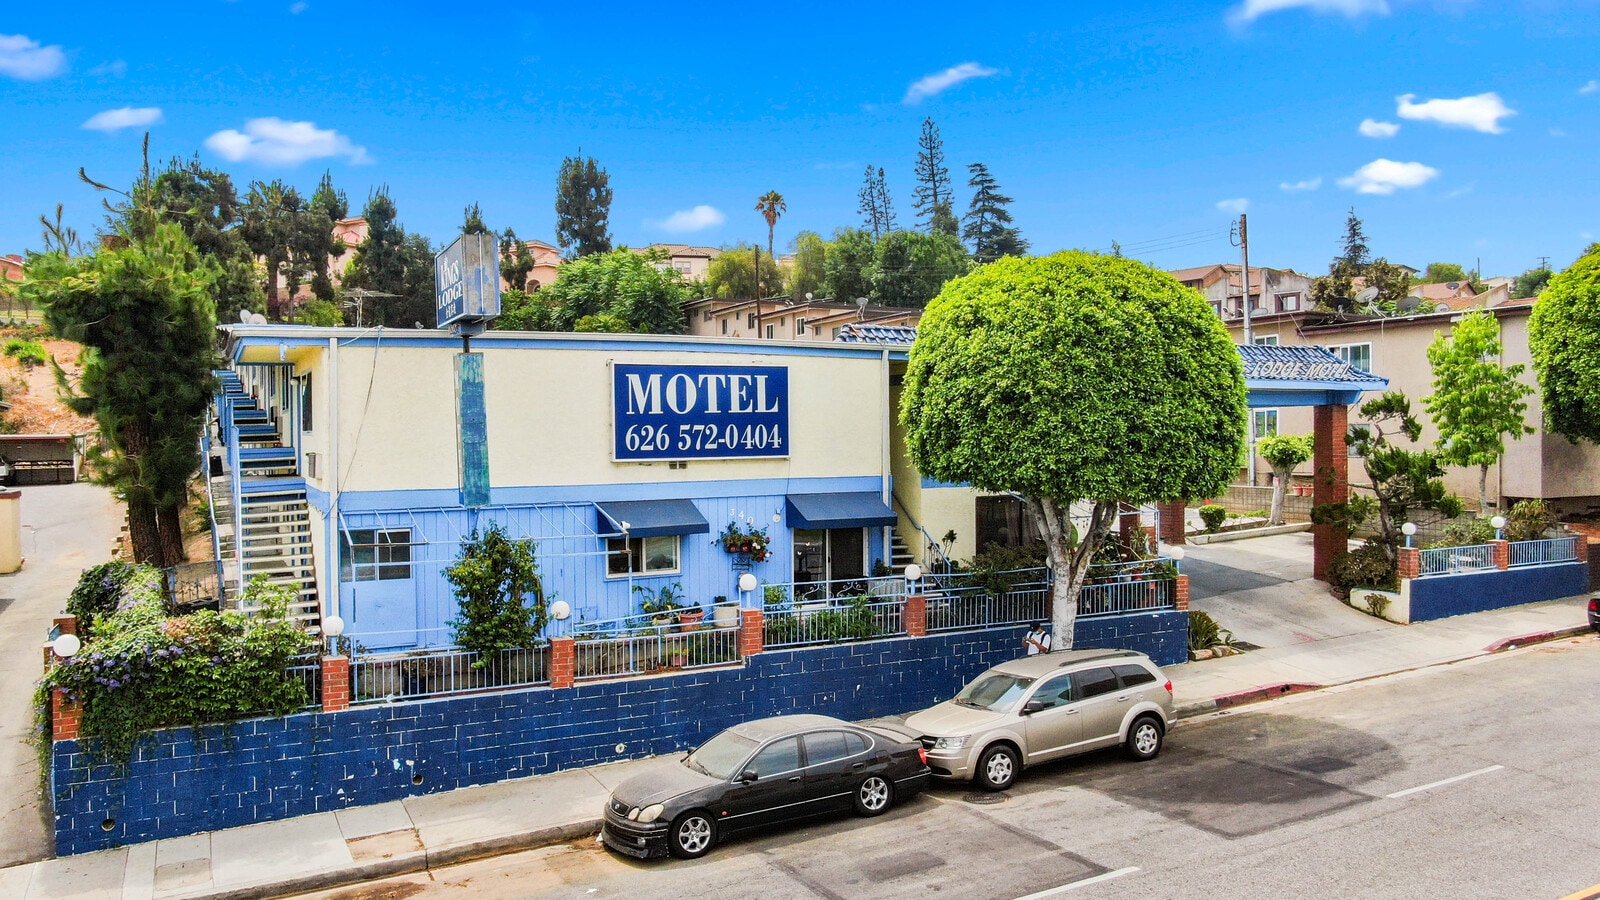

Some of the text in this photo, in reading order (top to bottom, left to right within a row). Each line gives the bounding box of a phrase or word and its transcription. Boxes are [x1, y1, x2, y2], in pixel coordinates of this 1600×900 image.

[438, 281, 463, 310] LODGE
[1251, 361, 1350, 378] LODGE MOTEL
[625, 373, 779, 415] MOTEL
[625, 423, 782, 451] 626 572-0404
[730, 508, 754, 525] 340
